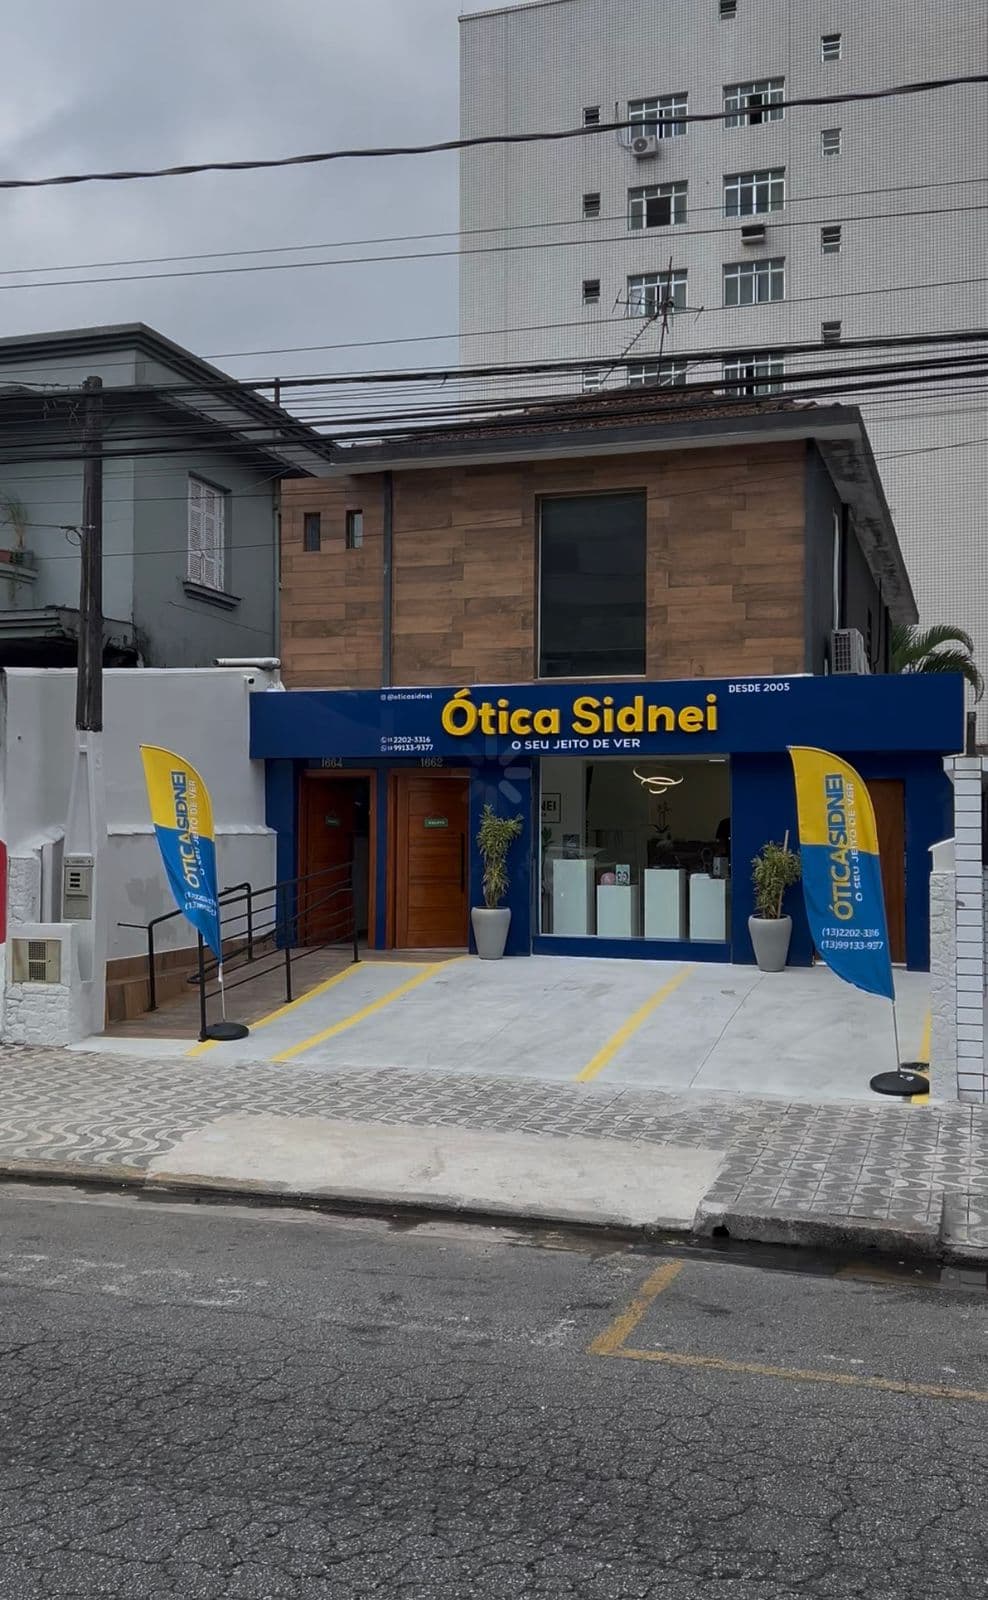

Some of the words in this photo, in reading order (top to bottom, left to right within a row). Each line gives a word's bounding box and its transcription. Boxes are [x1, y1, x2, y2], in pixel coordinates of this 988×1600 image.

[728, 684, 760, 693] DESDE
[763, 682, 790, 692] 2005
[441, 688, 560, 736] Ótica
[571, 693, 718, 734] Sidnei
[511, 740, 521, 750] O
[524, 740, 549, 750] SEU
[553, 739, 589, 749] JEITO
[593, 738, 610, 749] DE
[613, 738, 641, 748] VER
[824, 773, 854, 920] ÓTICASIDNEI
[849, 828, 860, 862] JEITO
[852, 865, 862, 889] SEU
[855, 892, 863, 902] O
